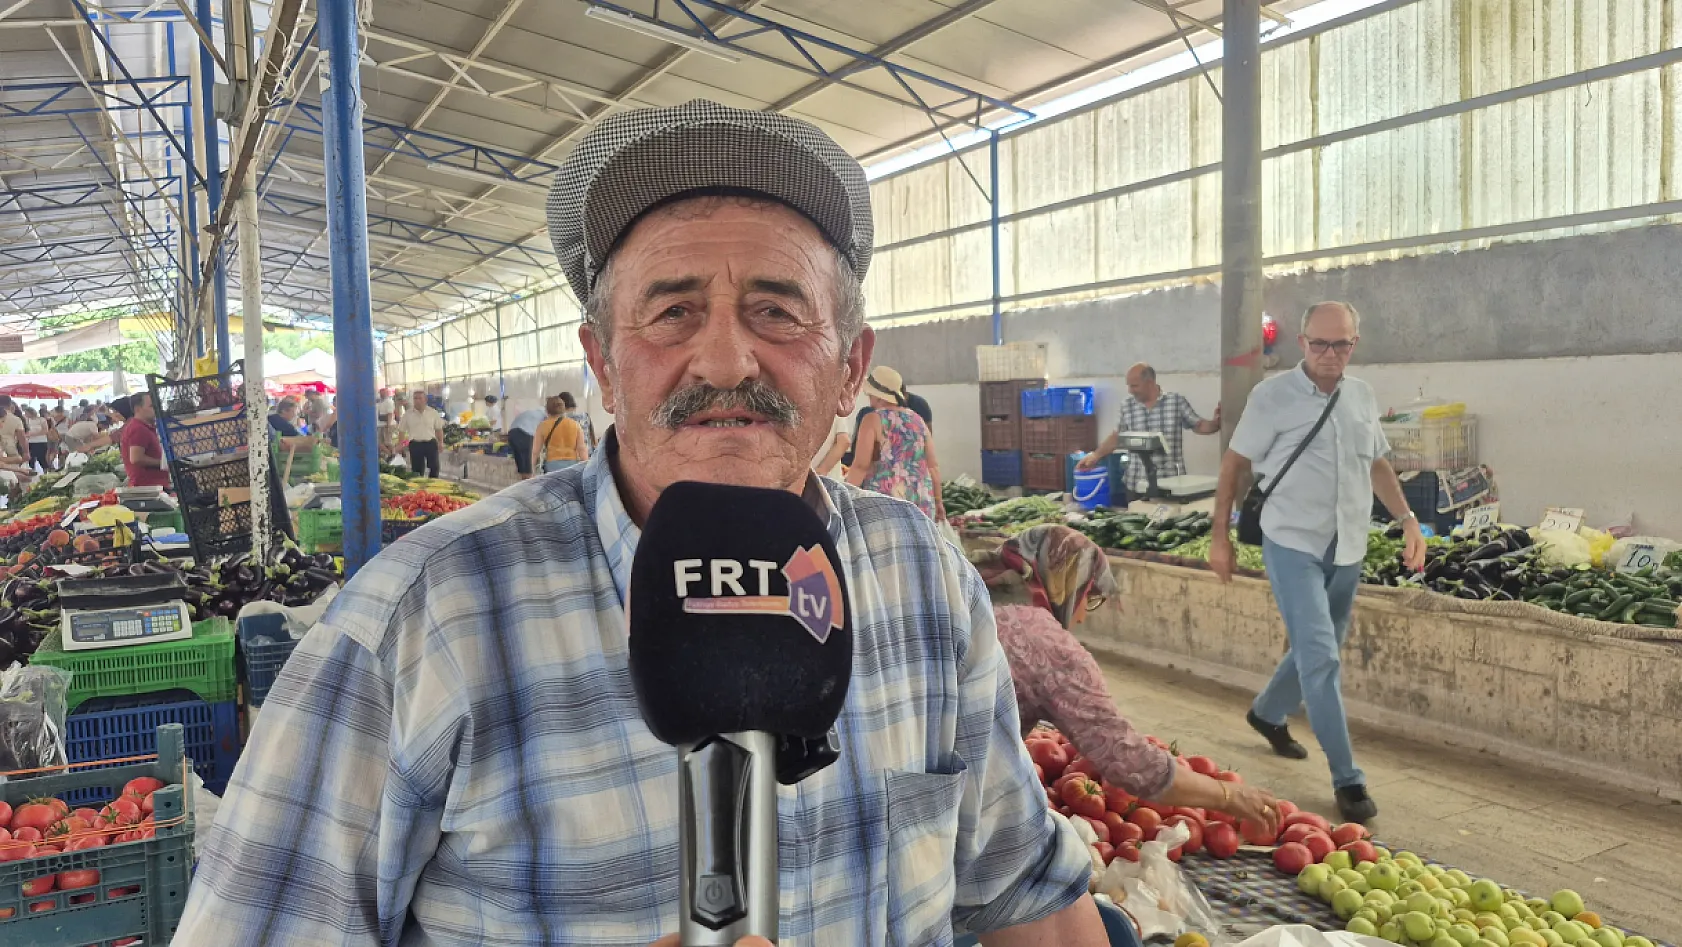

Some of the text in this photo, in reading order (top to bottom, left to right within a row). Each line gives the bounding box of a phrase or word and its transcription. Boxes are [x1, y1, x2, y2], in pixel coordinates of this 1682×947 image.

[1624, 549, 1651, 568] 10
[673, 558, 828, 619] FRT tv
